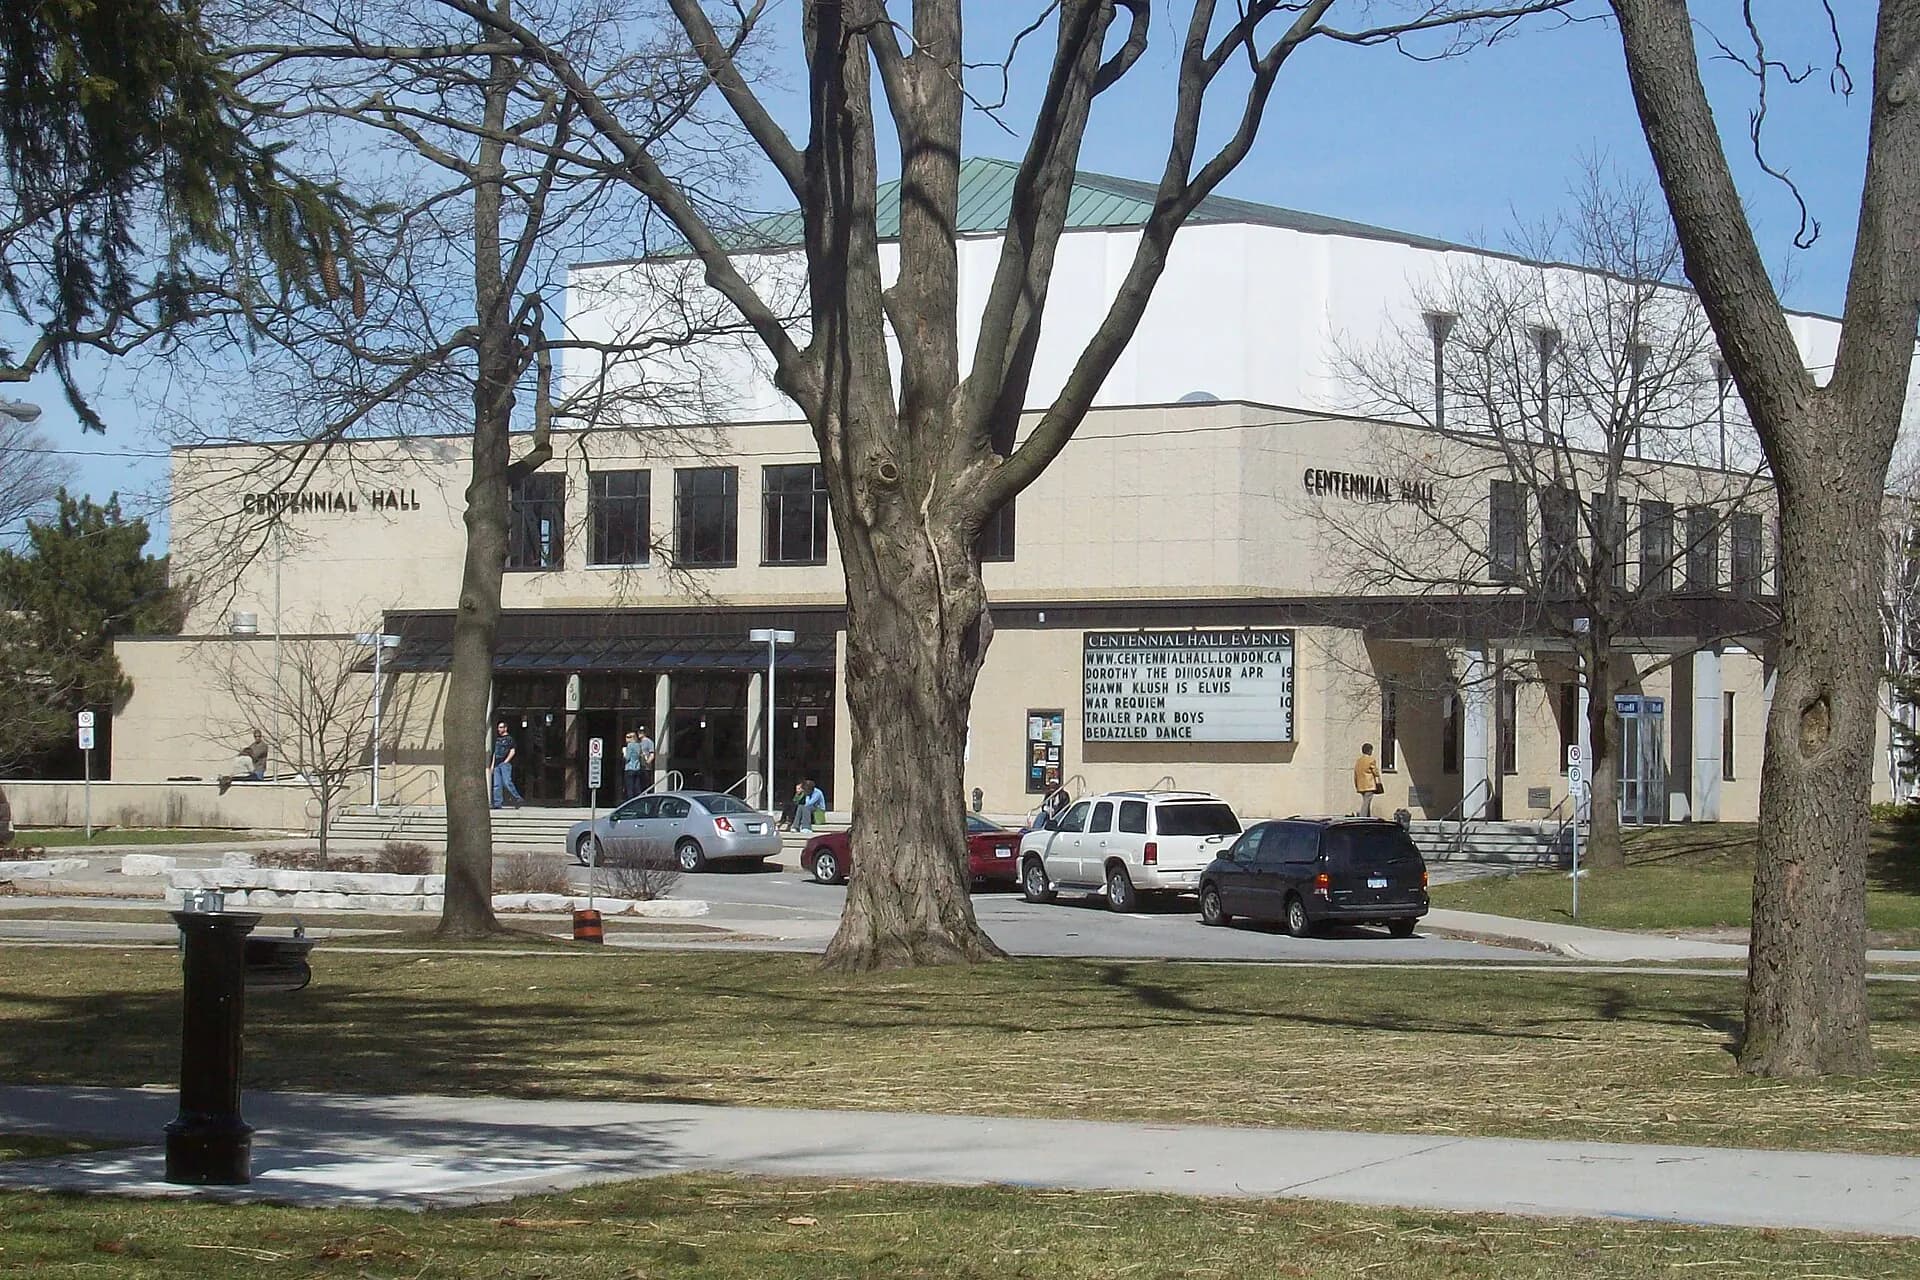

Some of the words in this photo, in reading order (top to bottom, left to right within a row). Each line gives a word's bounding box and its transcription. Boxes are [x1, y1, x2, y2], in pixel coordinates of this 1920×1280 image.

[1304, 468, 1392, 505] CENTENNIAL
[1400, 480, 1436, 510] HALL
[243, 491, 358, 515] CENTENNIAL
[373, 488, 420, 511] HALL
[1088, 634, 1184, 647] CENTENNIAL
[1188, 633, 1227, 646] HALL
[1231, 632, 1290, 646] EVENTS
[1086, 651, 1282, 665] WWW.CENTENNIALHALL.LONDON.CA
[1086, 667, 1137, 679] DOROTHY
[1146, 667, 1167, 679] THE
[1175, 667, 1231, 679] DINOSAUR
[1240, 666, 1264, 678] APR
[1281, 666, 1293, 678] 19
[1085, 681, 1122, 694] SHAWN
[1132, 681, 1168, 694] KLUSH
[1176, 681, 1188, 694] IS
[1198, 681, 1231, 694] ELVIS
[1086, 697, 1108, 709] WAR
[1115, 697, 1165, 709] REQUIEM
[1280, 696, 1292, 708] 10
[1617, 702, 1635, 712] Bell
[1086, 711, 1131, 724] TRAILER
[1136, 711, 1166, 724] PARK
[1174, 711, 1204, 724] BOYS
[1285, 711, 1293, 723] 9
[1086, 726, 1147, 739] BEDAZZLED
[1156, 726, 1193, 739] DANCE
